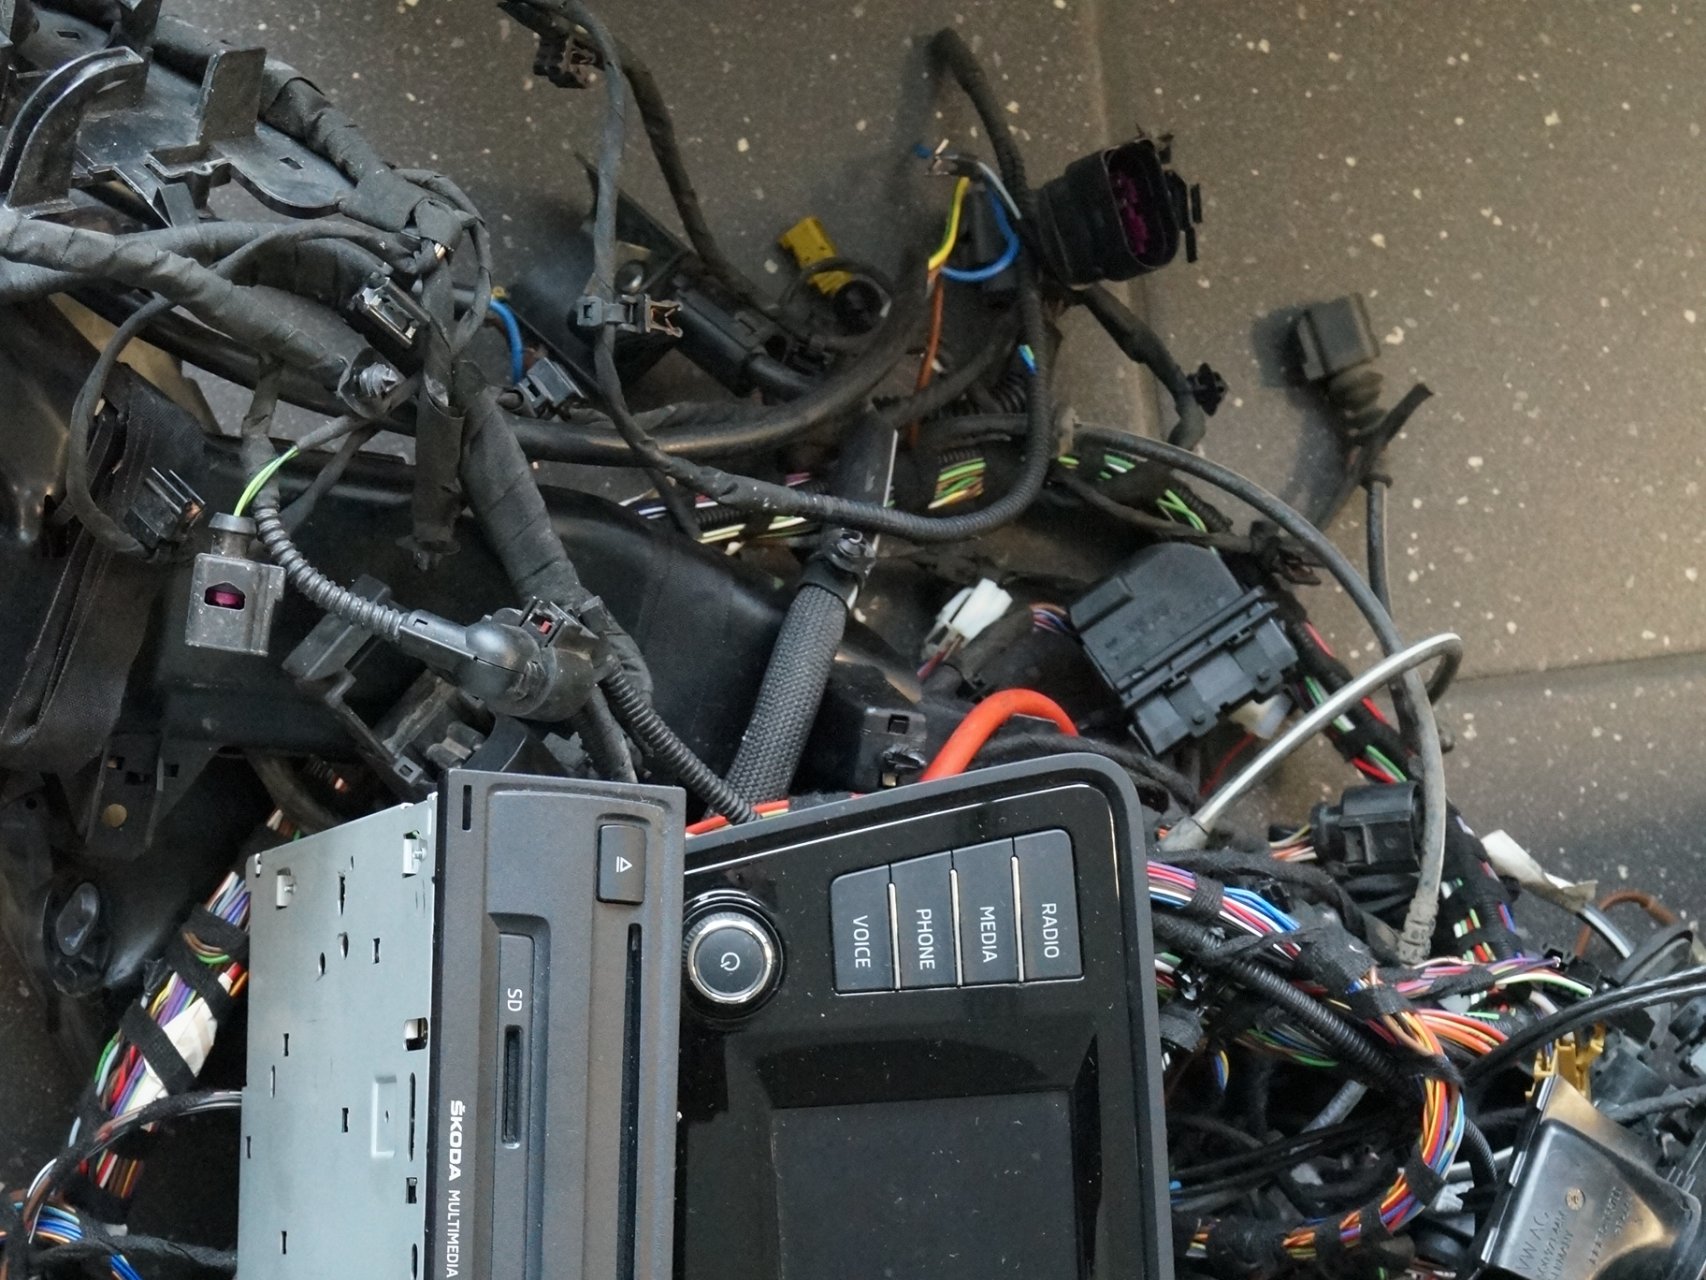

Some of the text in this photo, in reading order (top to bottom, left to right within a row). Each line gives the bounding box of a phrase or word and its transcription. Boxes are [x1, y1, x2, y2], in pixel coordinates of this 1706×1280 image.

[852, 915, 871, 968] VOICE
[916, 908, 936, 970] PHONE
[979, 906, 998, 963] MEDIA
[1041, 903, 1060, 959] RADIO
[507, 988, 523, 1012] SD
[446, 1100, 466, 1279] ŠKODA MULTIMEDIA
